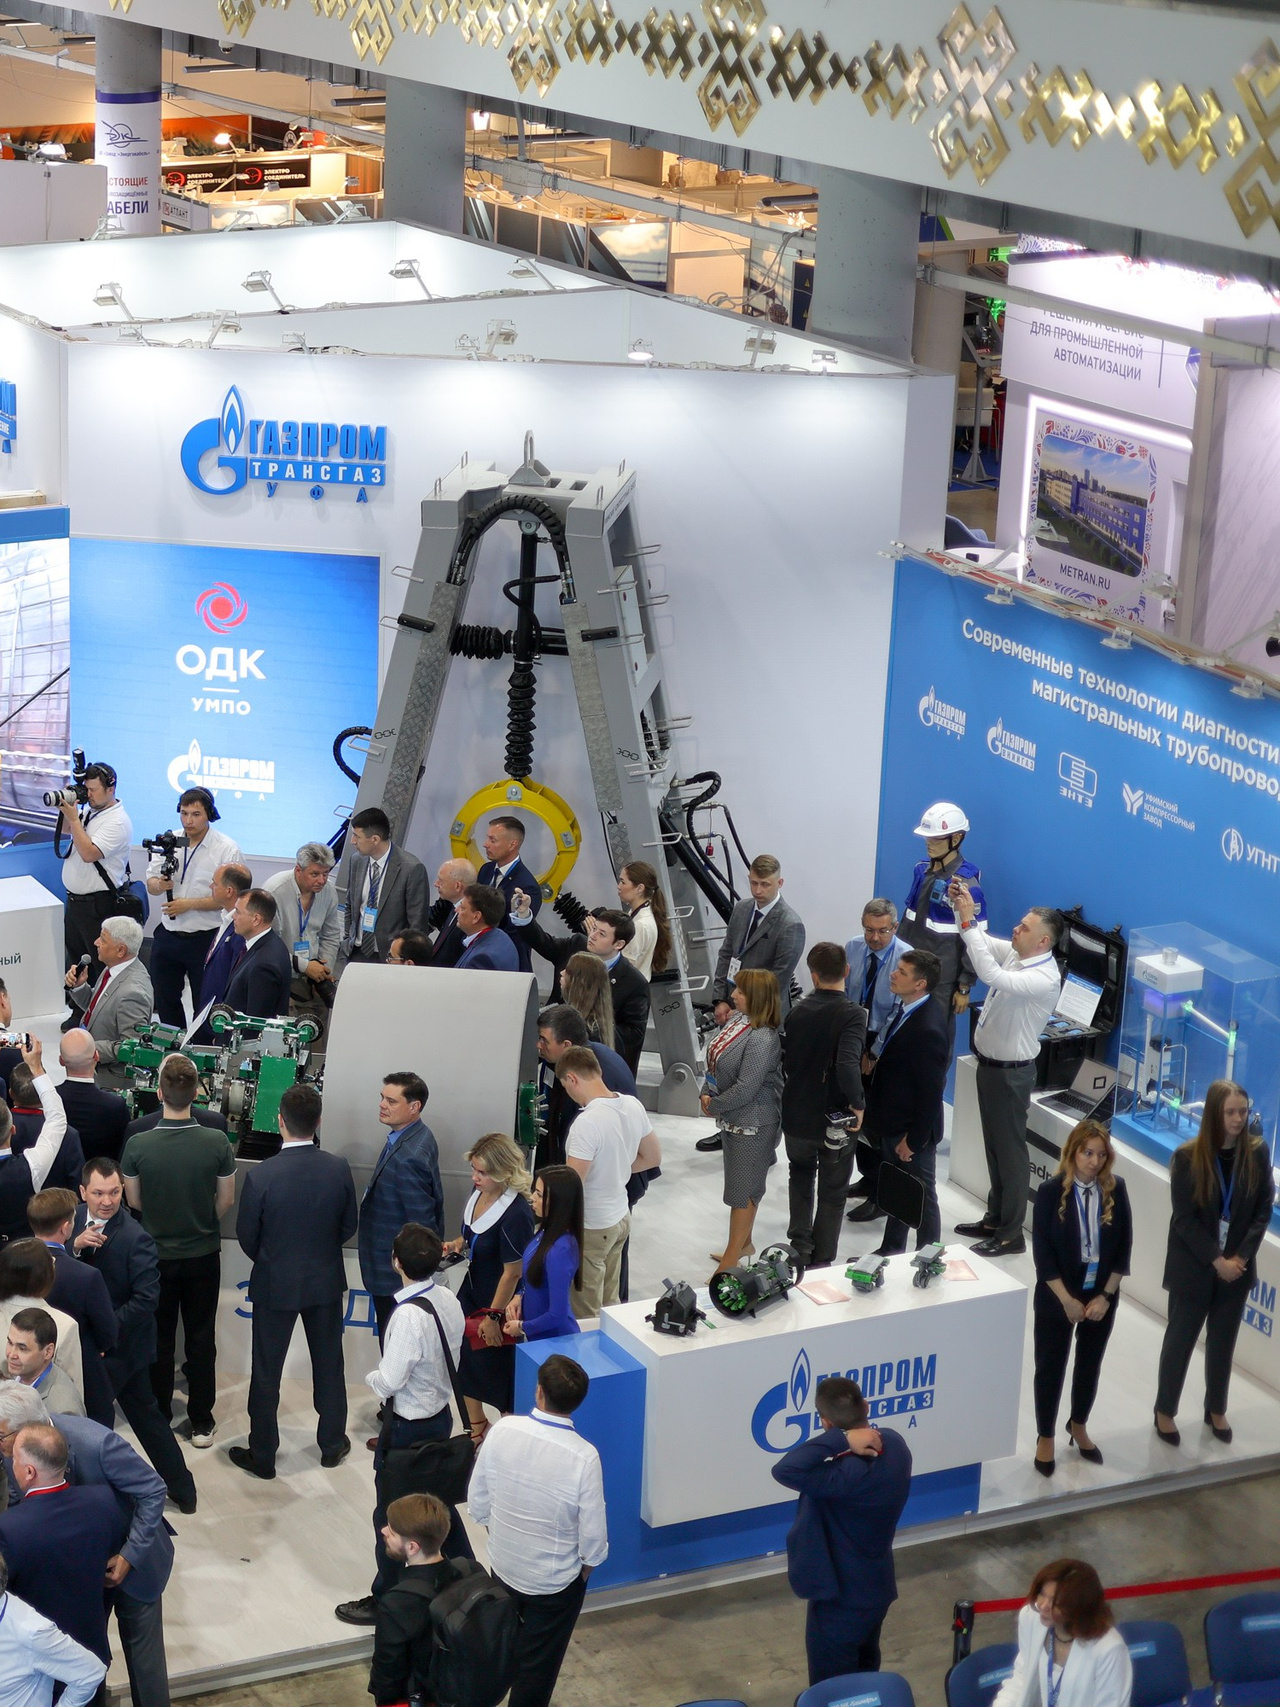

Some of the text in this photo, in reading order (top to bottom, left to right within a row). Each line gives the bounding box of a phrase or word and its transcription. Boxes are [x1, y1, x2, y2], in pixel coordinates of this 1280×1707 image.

[107, 176, 149, 188] СТОЯЩИЕ
[107, 201, 149, 215] АБЕЛИ
[1029, 320, 1144, 361] ДЛЯ ПРОМЫШЛЕННОЙ
[1053, 347, 1142, 382] АВТОМАТИЗАЦИИ
[249, 419, 388, 461] ГАЗПРОМ
[252, 461, 382, 483] ТРАНСГАЗ
[266, 481, 369, 504] УФА
[1059, 561, 1112, 591] METRAN.RU
[176, 644, 267, 682] ОДК
[962, 618, 1074, 681] Современные
[1077, 666, 1180, 725] технологии
[192, 697, 251, 716] УМПО
[935, 699, 966, 727] ГАЗПРОМ
[1002, 730, 1037, 758] ГАЗПРОМ
[1031, 678, 1280, 802] магистральных трубопрово
[202, 755, 275, 781] ГАЗПРОМ
[1001, 747, 1036, 772] ВНИИГАЗ
[1143, 802, 1196, 833] КОМПРЕССОРНЫЙ
[1144, 792, 1179, 815] УФИМСКИЙ
[1143, 811, 1163, 830] ЗАВОД
